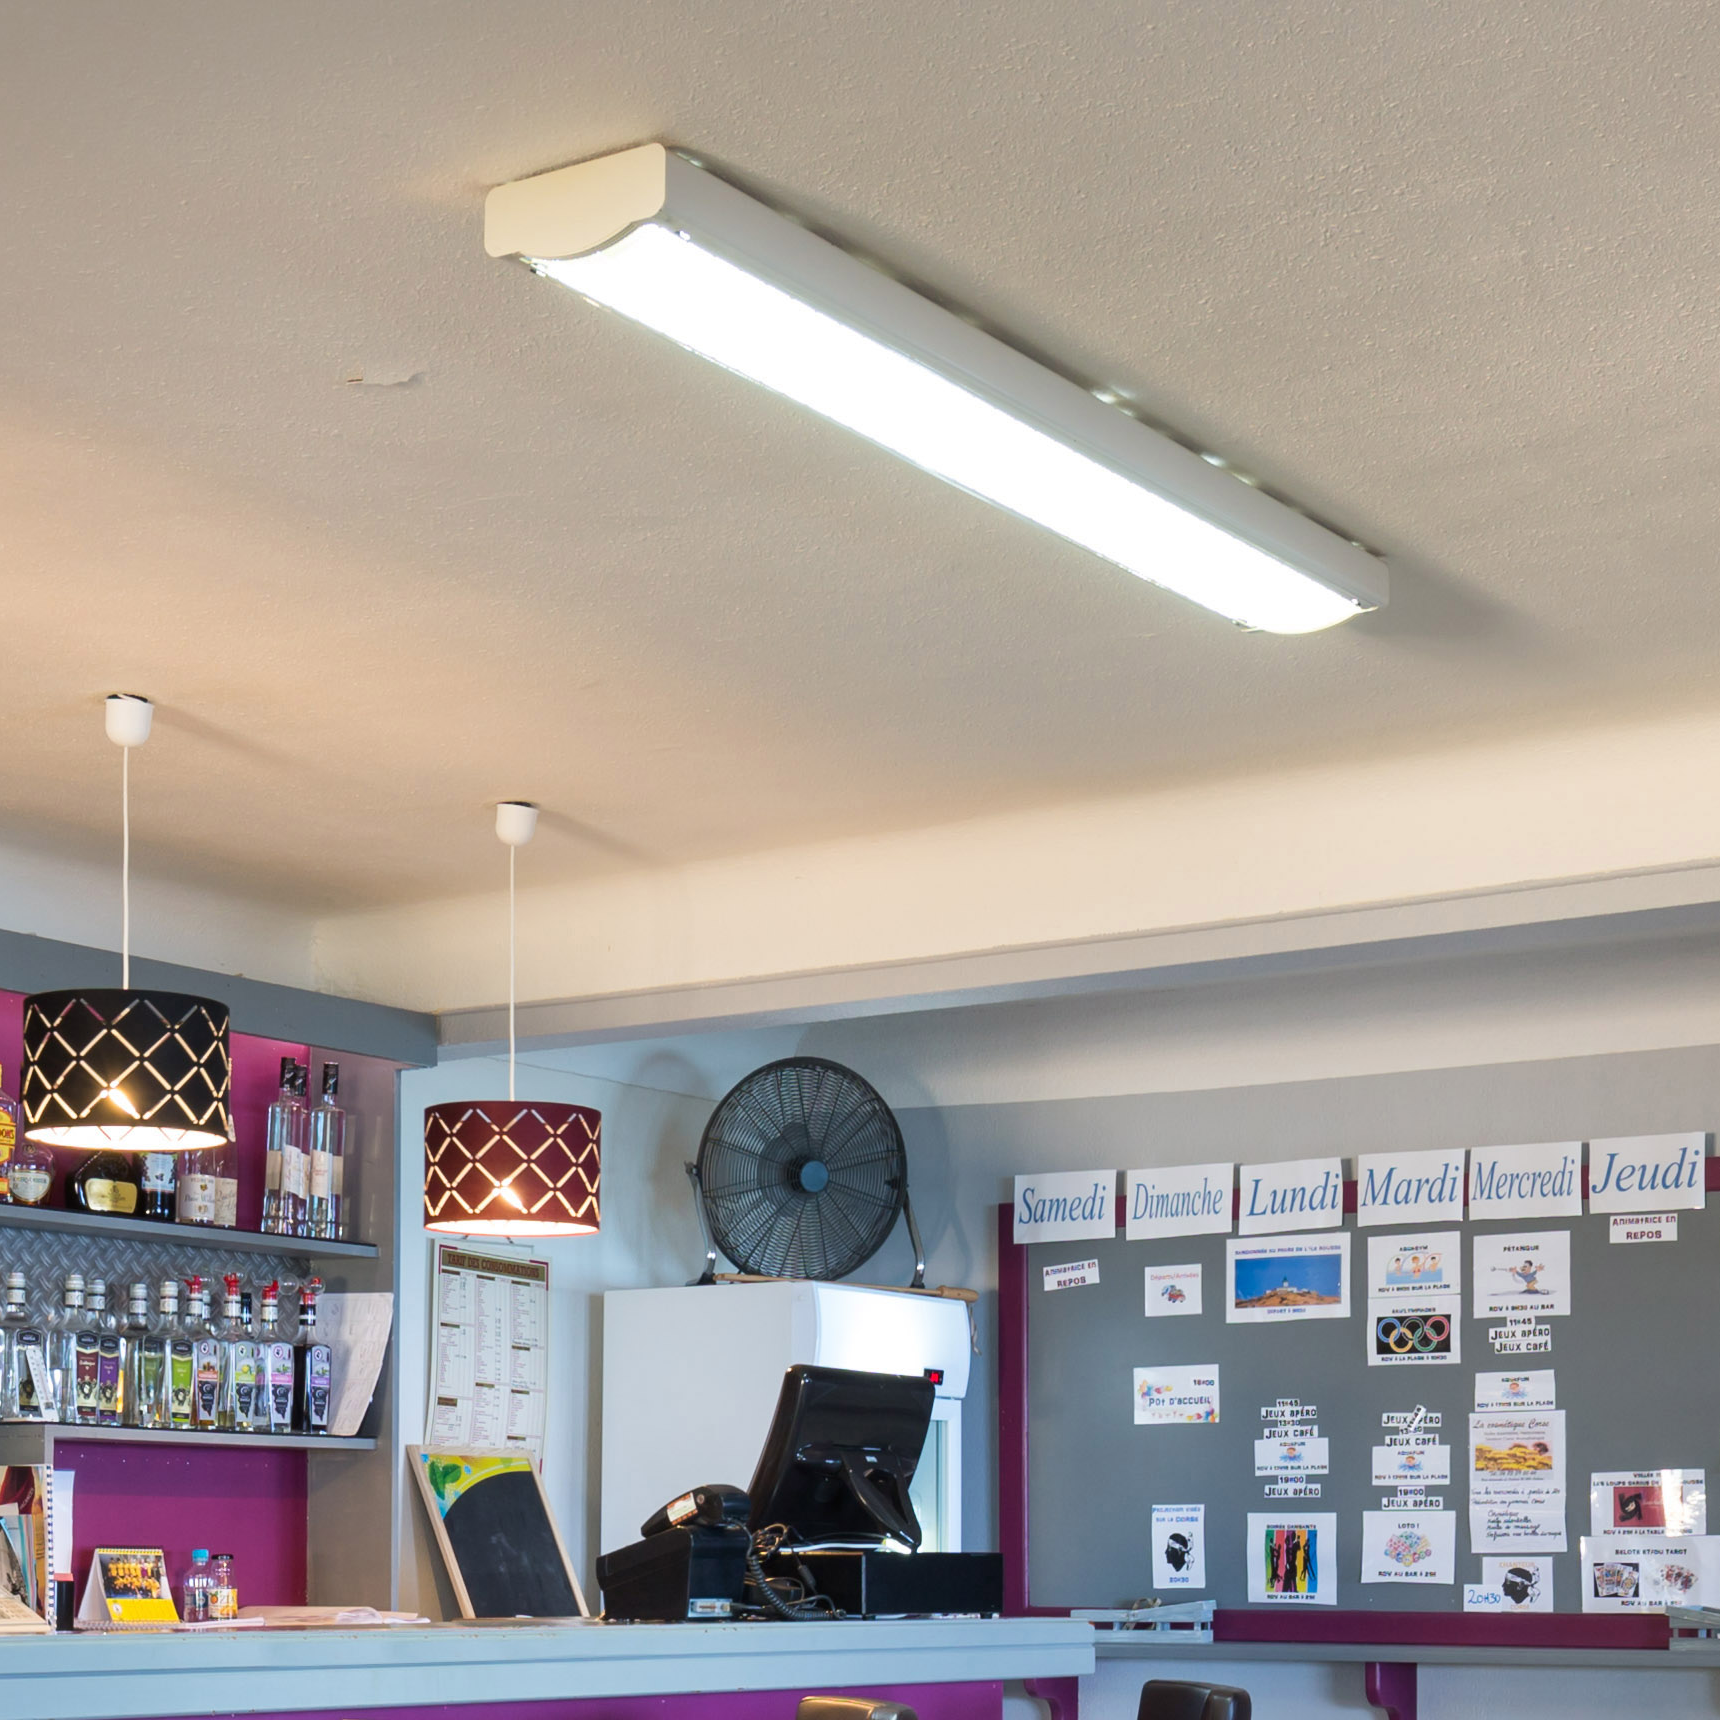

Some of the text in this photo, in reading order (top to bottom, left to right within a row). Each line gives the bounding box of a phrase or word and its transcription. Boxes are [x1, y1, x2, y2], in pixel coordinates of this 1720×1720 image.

[1591, 1147, 1700, 1195] Jeudi
[1471, 1156, 1576, 1201] Mercredi
[1360, 1162, 1460, 1208] Mardi
[1132, 1177, 1223, 1220] Dimanche
[1246, 1171, 1340, 1217] Lundi
[1018, 1183, 1107, 1224] Samedi
[1626, 1230, 1662, 1241] REPOS
[1057, 1275, 1086, 1288] REPOS
[1491, 1330, 1516, 1341] JEUX
[1496, 1342, 1521, 1352] JEUX
[1262, 1409, 1285, 1419] JEUX
[1265, 1429, 1289, 1439] JEUX
[1386, 1437, 1411, 1447] JEUX
[1265, 1487, 1288, 1497] JEUX
[1383, 1499, 1408, 1508] JEUX
